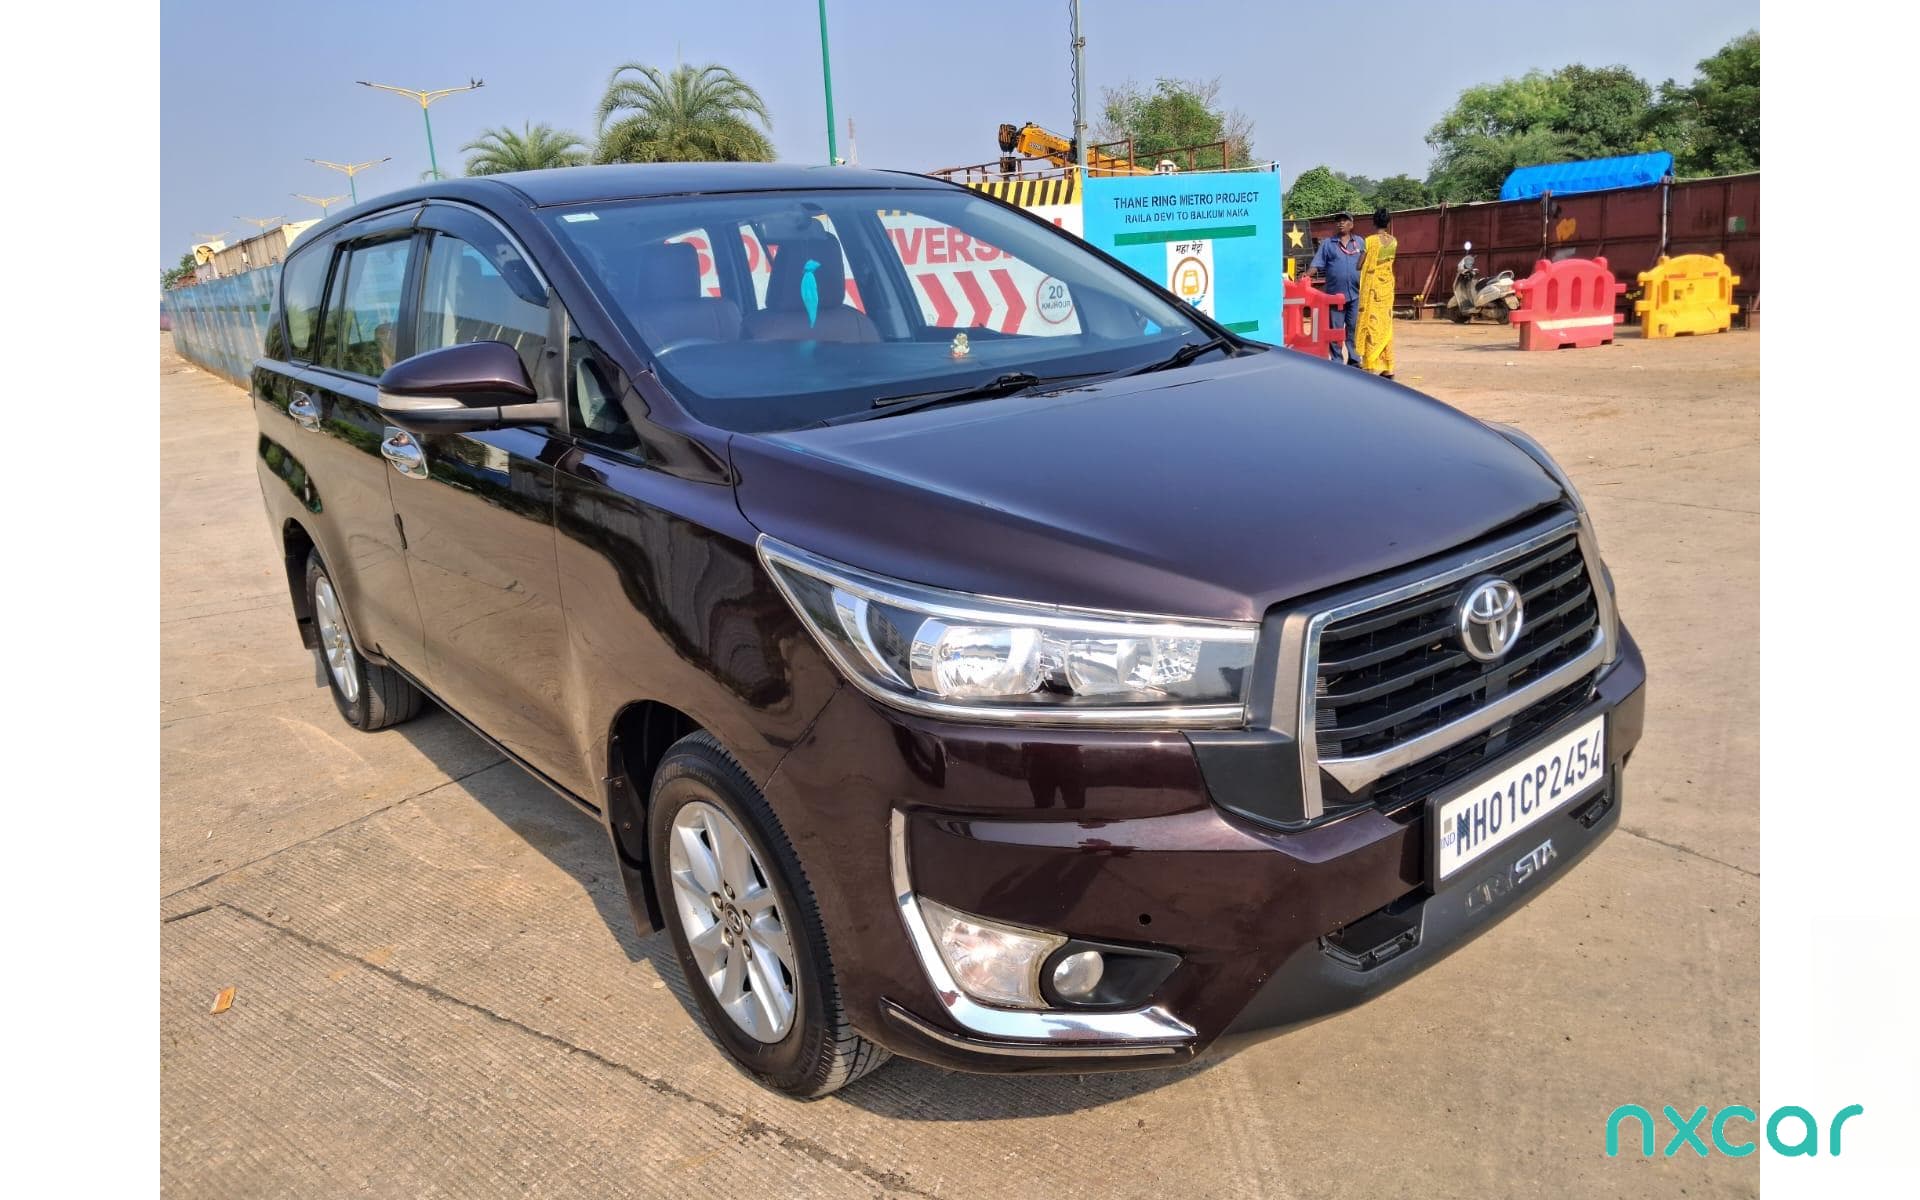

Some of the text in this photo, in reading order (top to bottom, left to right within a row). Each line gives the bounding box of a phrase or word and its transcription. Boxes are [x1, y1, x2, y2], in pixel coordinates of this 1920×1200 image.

[1113, 191, 1259, 209] THANE RING METRO PROJECT
[1125, 207, 1249, 224] RAILA DEVI TO BALKUM NAKA
[1048, 285, 1063, 300] 20
[1456, 729, 1601, 857] MH01CP2454
